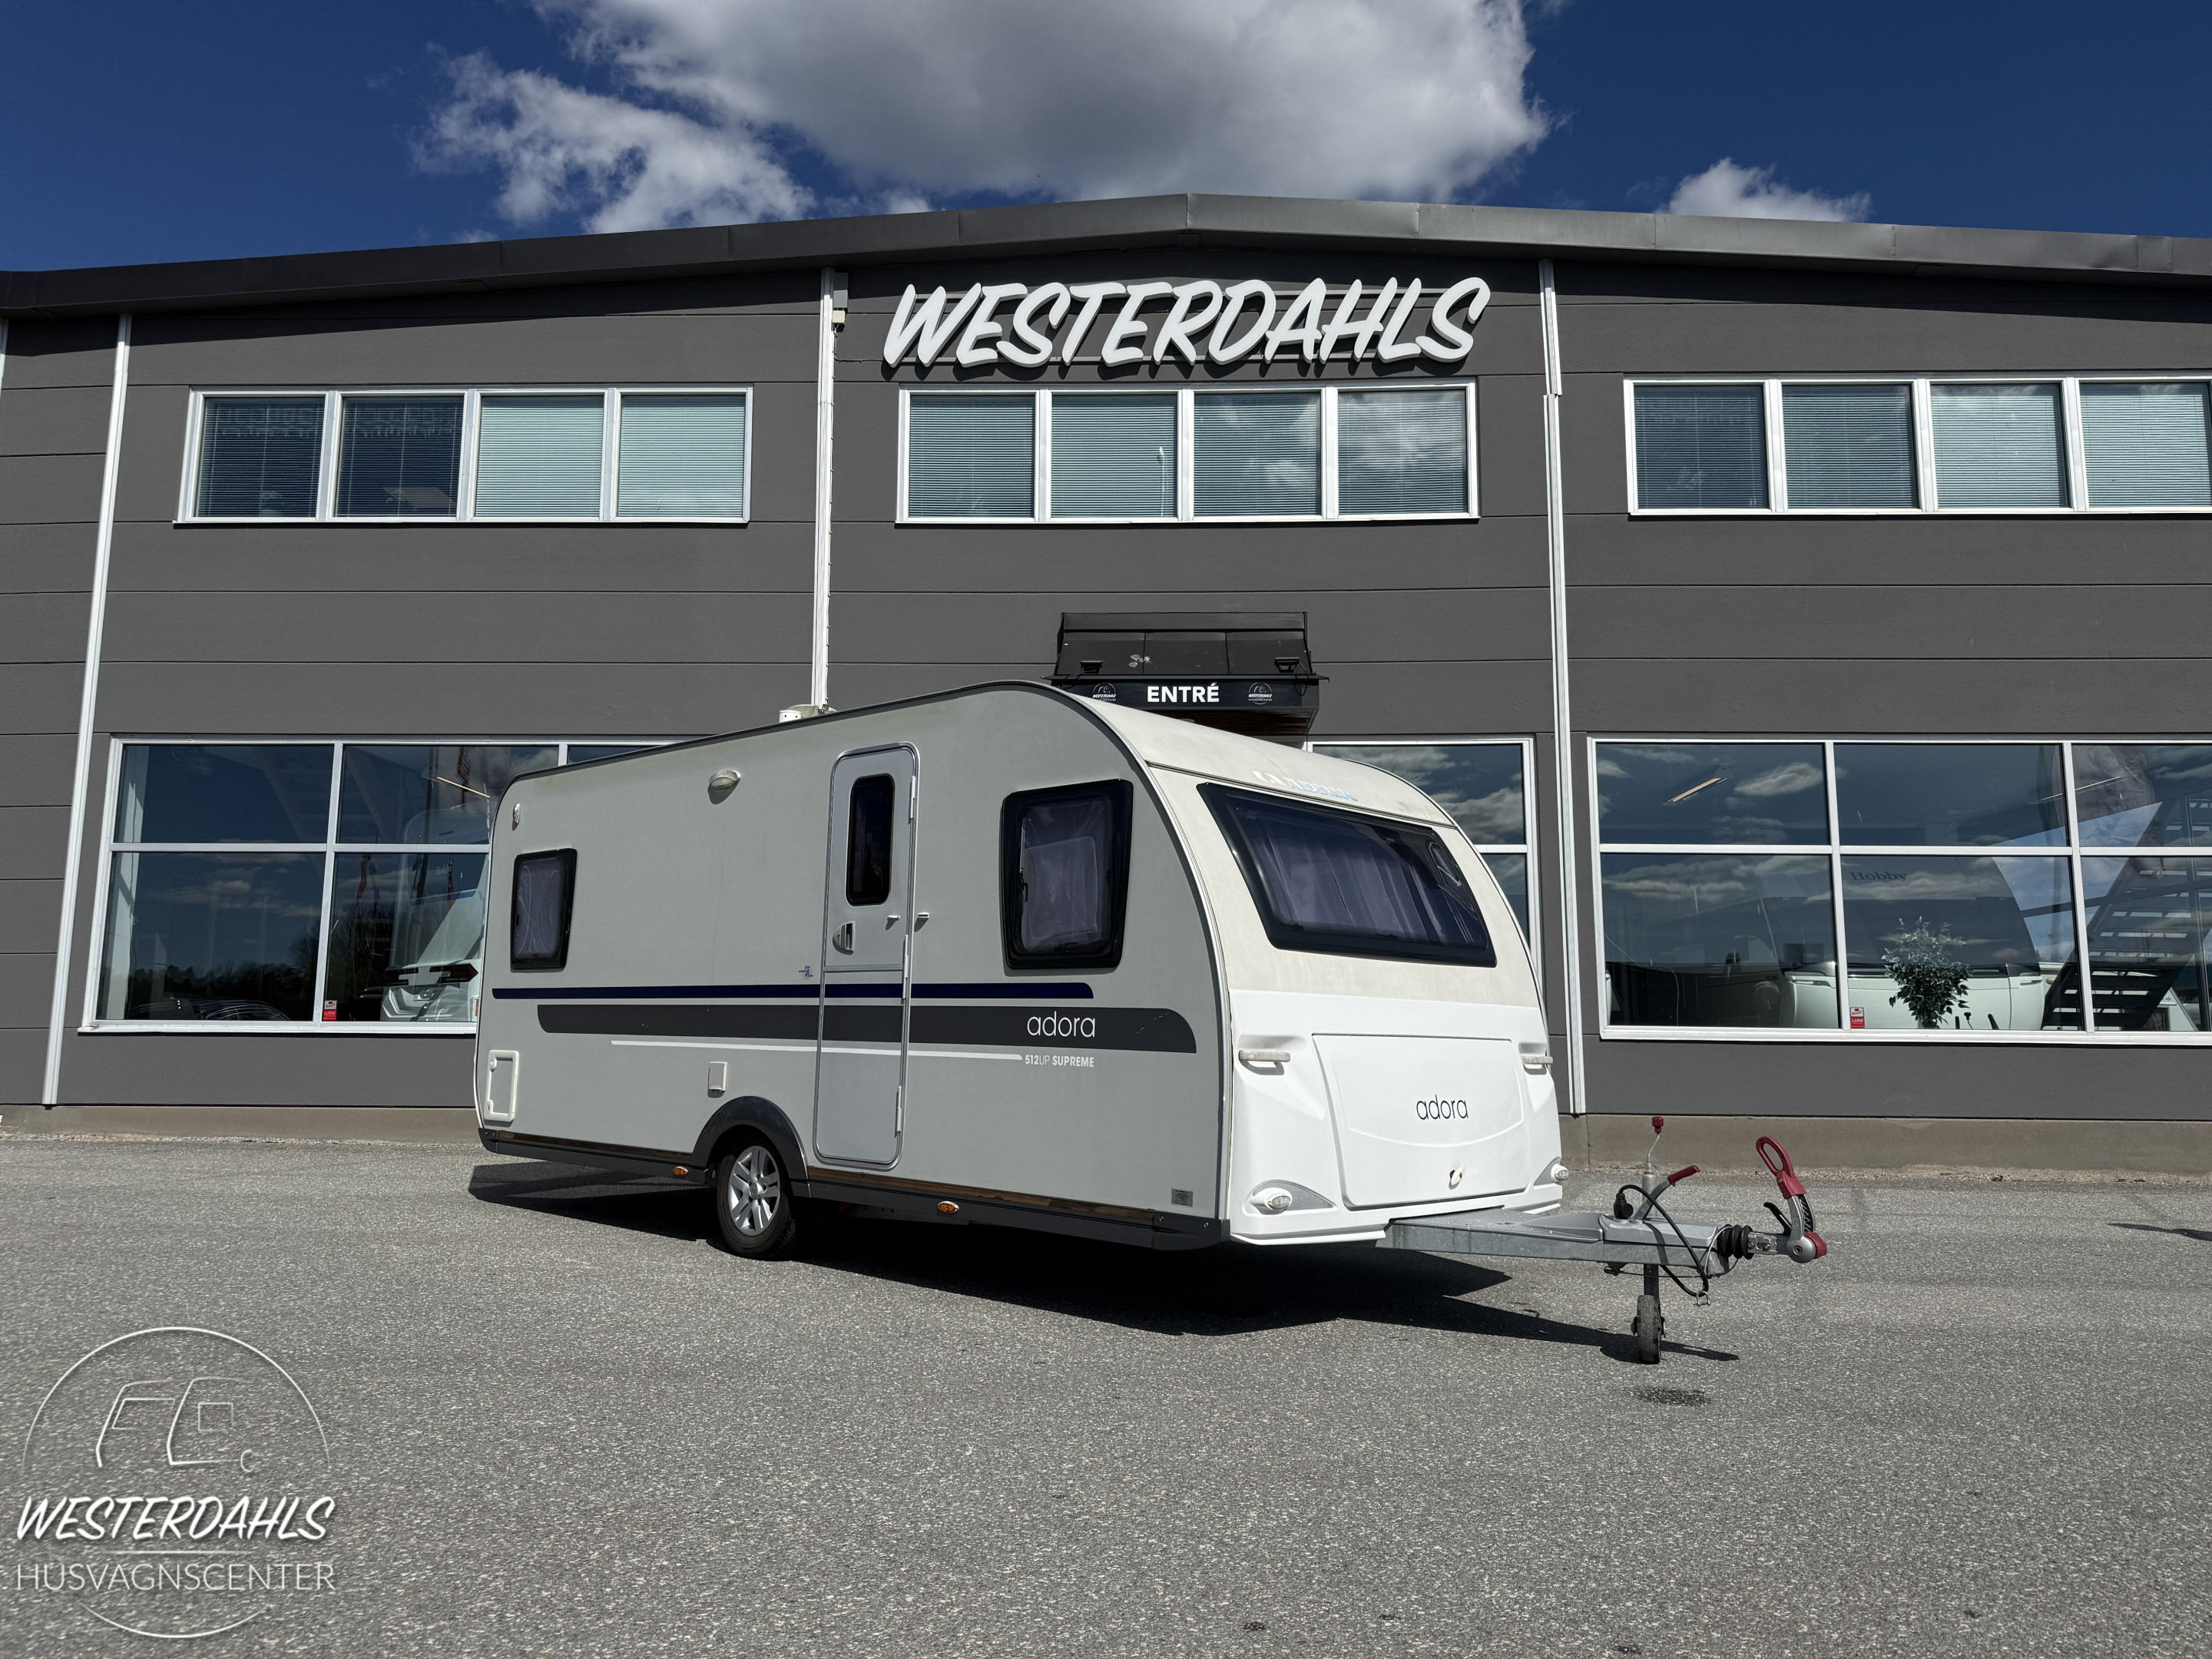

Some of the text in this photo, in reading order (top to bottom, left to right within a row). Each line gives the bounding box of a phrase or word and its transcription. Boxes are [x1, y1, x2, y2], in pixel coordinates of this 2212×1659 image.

[883, 276, 1492, 367] WESTERDAHLS
[1147, 681, 1220, 703] ENTRÉ
[1849, 871, 1907, 882] Hobby
[1026, 1010, 1096, 1038] adora
[1025, 1055, 1094, 1068] 512UP SUPREME
[1416, 1094, 1469, 1120] adora
